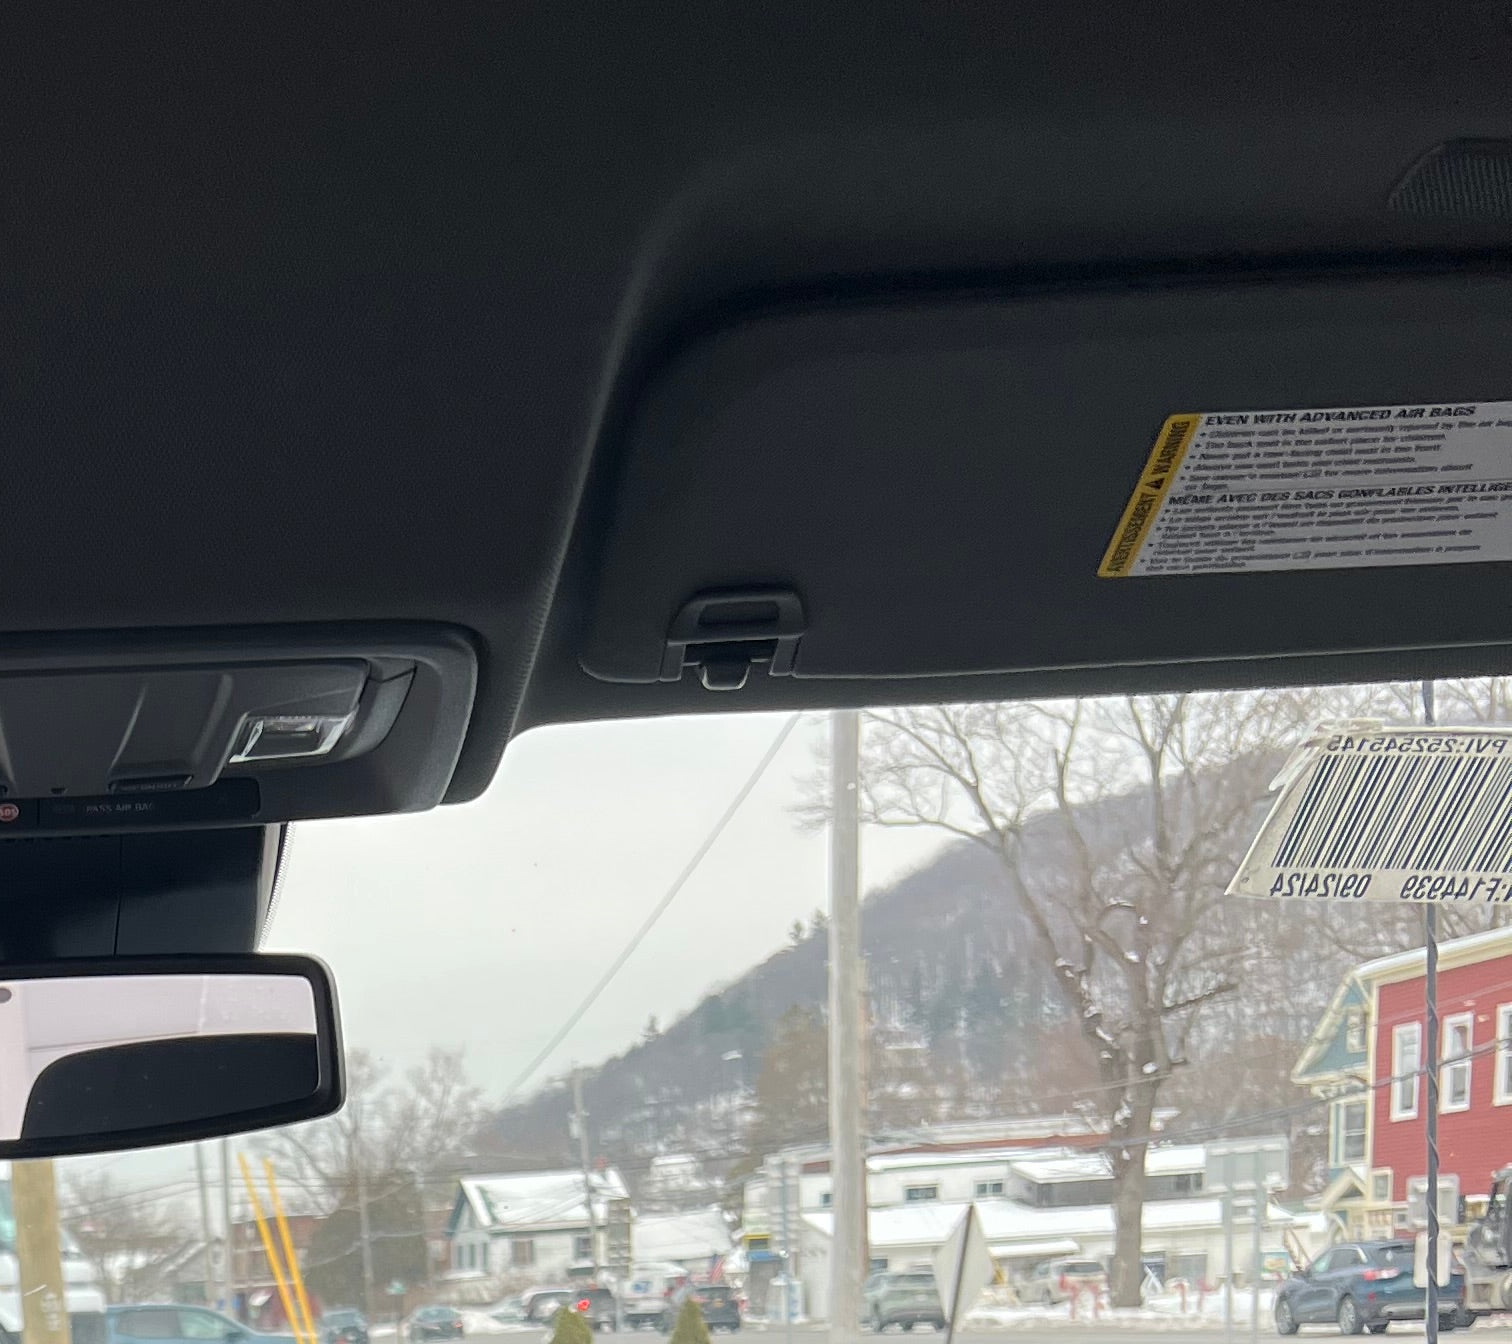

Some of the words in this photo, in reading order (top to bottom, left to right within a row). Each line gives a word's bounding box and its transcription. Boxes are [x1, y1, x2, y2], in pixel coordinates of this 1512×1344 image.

[1205, 415, 1249, 425] EVEN
[1253, 413, 1297, 424] WITH
[1299, 410, 1391, 422] ADVANCED
[1394, 408, 1426, 418] AIR
[1429, 406, 1477, 417] BAGS
